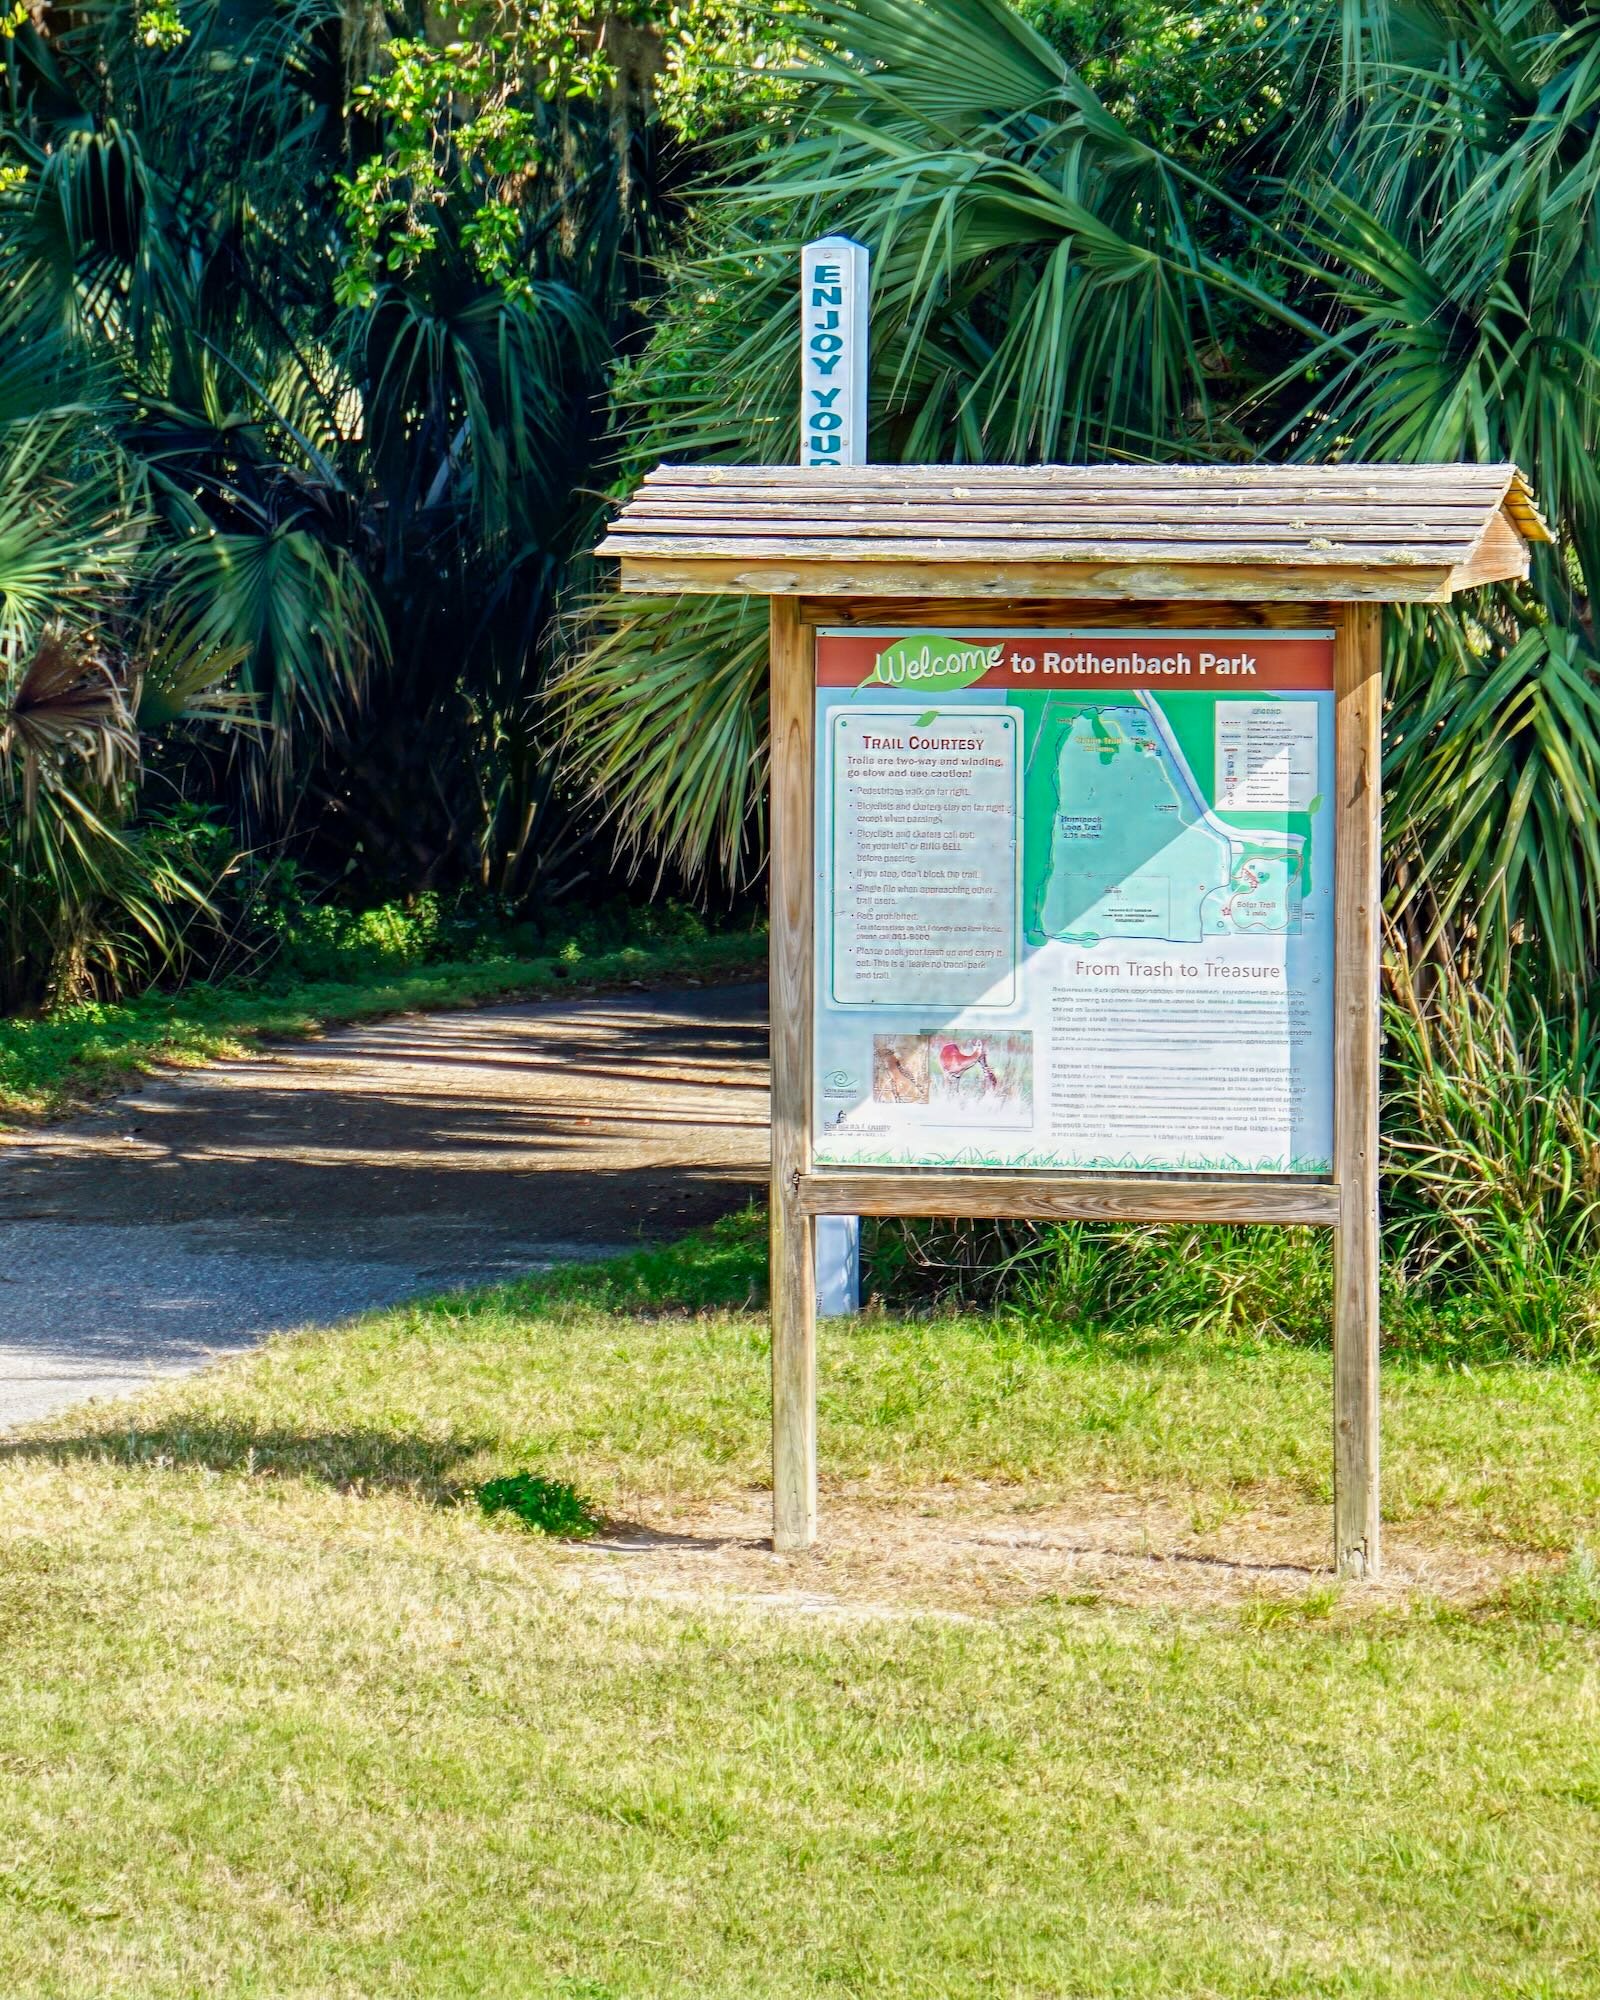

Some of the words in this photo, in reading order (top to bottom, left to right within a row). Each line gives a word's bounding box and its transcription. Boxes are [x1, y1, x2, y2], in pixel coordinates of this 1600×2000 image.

[811, 265, 843, 375] ENJOY
[809, 387, 842, 466] YOU
[876, 643, 1004, 685] Welcome
[1011, 653, 1036, 674] to
[1043, 652, 1192, 675] Rothenbach
[1200, 652, 1257, 675] Park
[1075, 962, 1120, 976] From
[1126, 962, 1173, 977] Trash
[1180, 964, 1198, 978] to
[1204, 962, 1280, 978] Treasure
